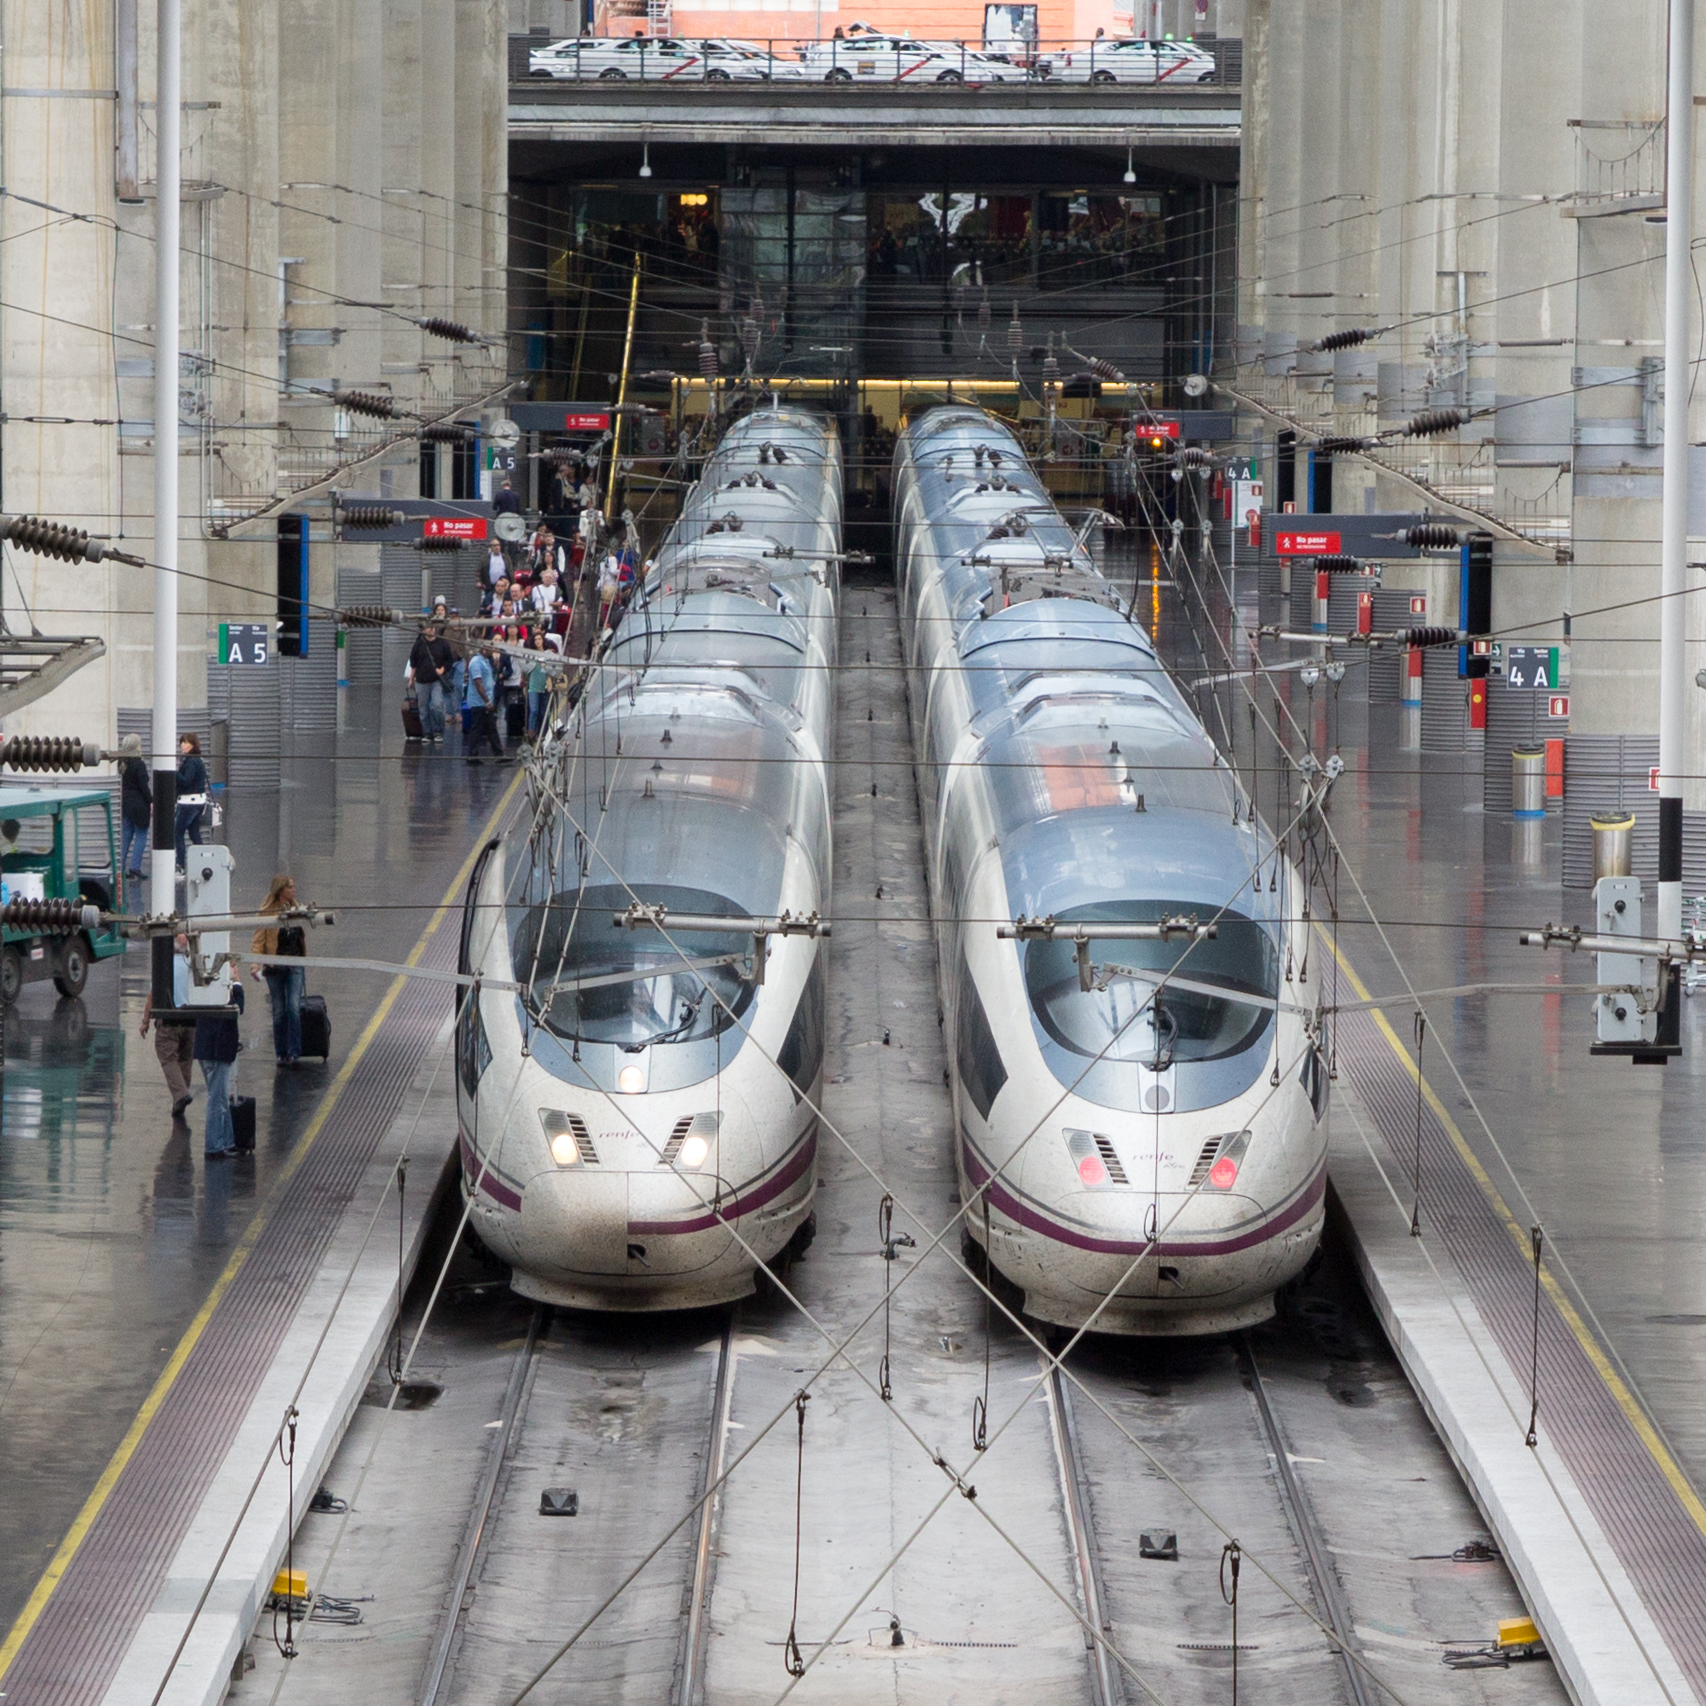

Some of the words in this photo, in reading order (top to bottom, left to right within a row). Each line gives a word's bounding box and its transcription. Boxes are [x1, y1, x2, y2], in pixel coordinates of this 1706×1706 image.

[492, 457, 501, 469] A
[507, 457, 515, 469] 5
[1228, 467, 1237, 479] 4
[1241, 467, 1251, 479] A
[228, 643, 243, 663] A
[254, 643, 267, 663] 5
[1510, 666, 1525, 687] 4
[1533, 666, 1548, 687] A
